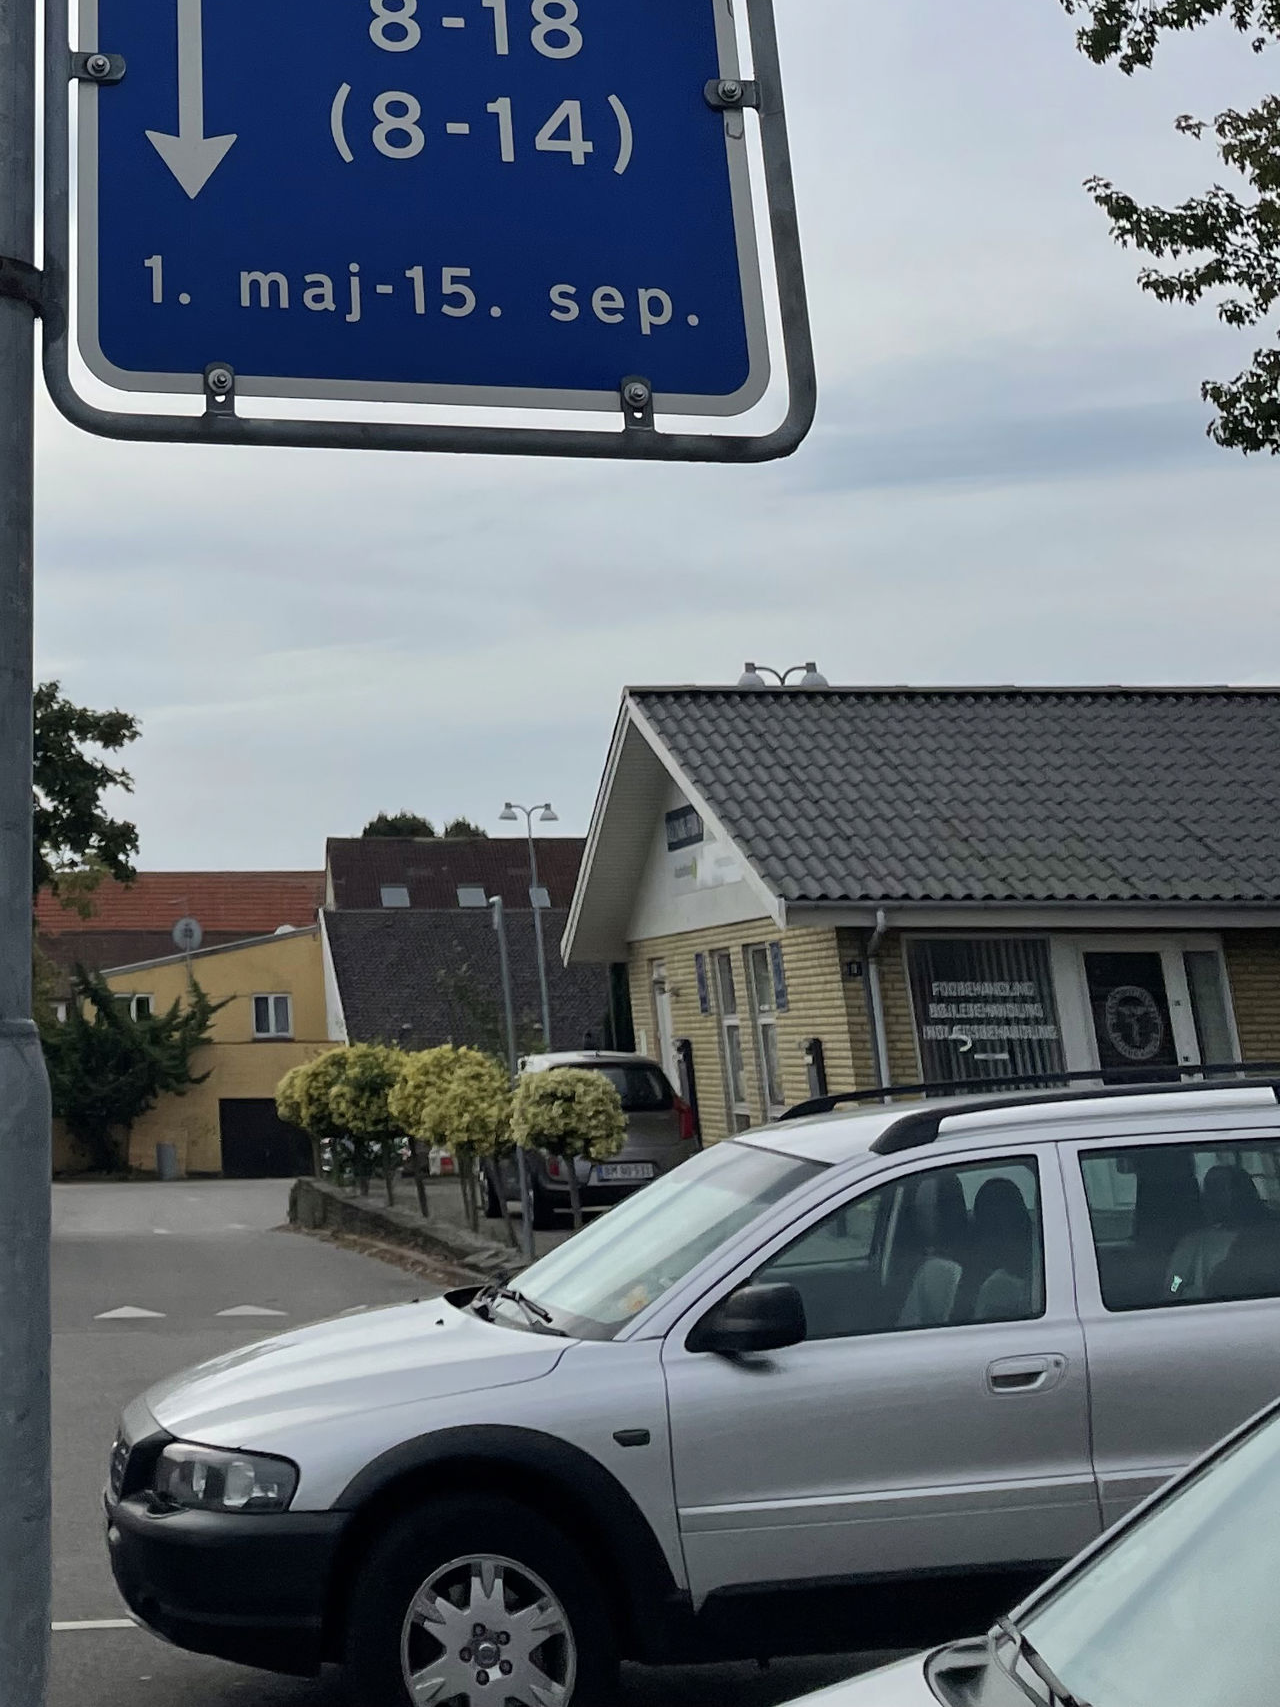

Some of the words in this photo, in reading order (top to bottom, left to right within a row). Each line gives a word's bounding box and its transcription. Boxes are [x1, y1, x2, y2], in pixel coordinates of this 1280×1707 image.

[329, 81, 634, 176] (8-14)
[143, 254, 192, 305] 1.
[239, 261, 502, 324] maj-15.
[548, 283, 700, 336] sep.
